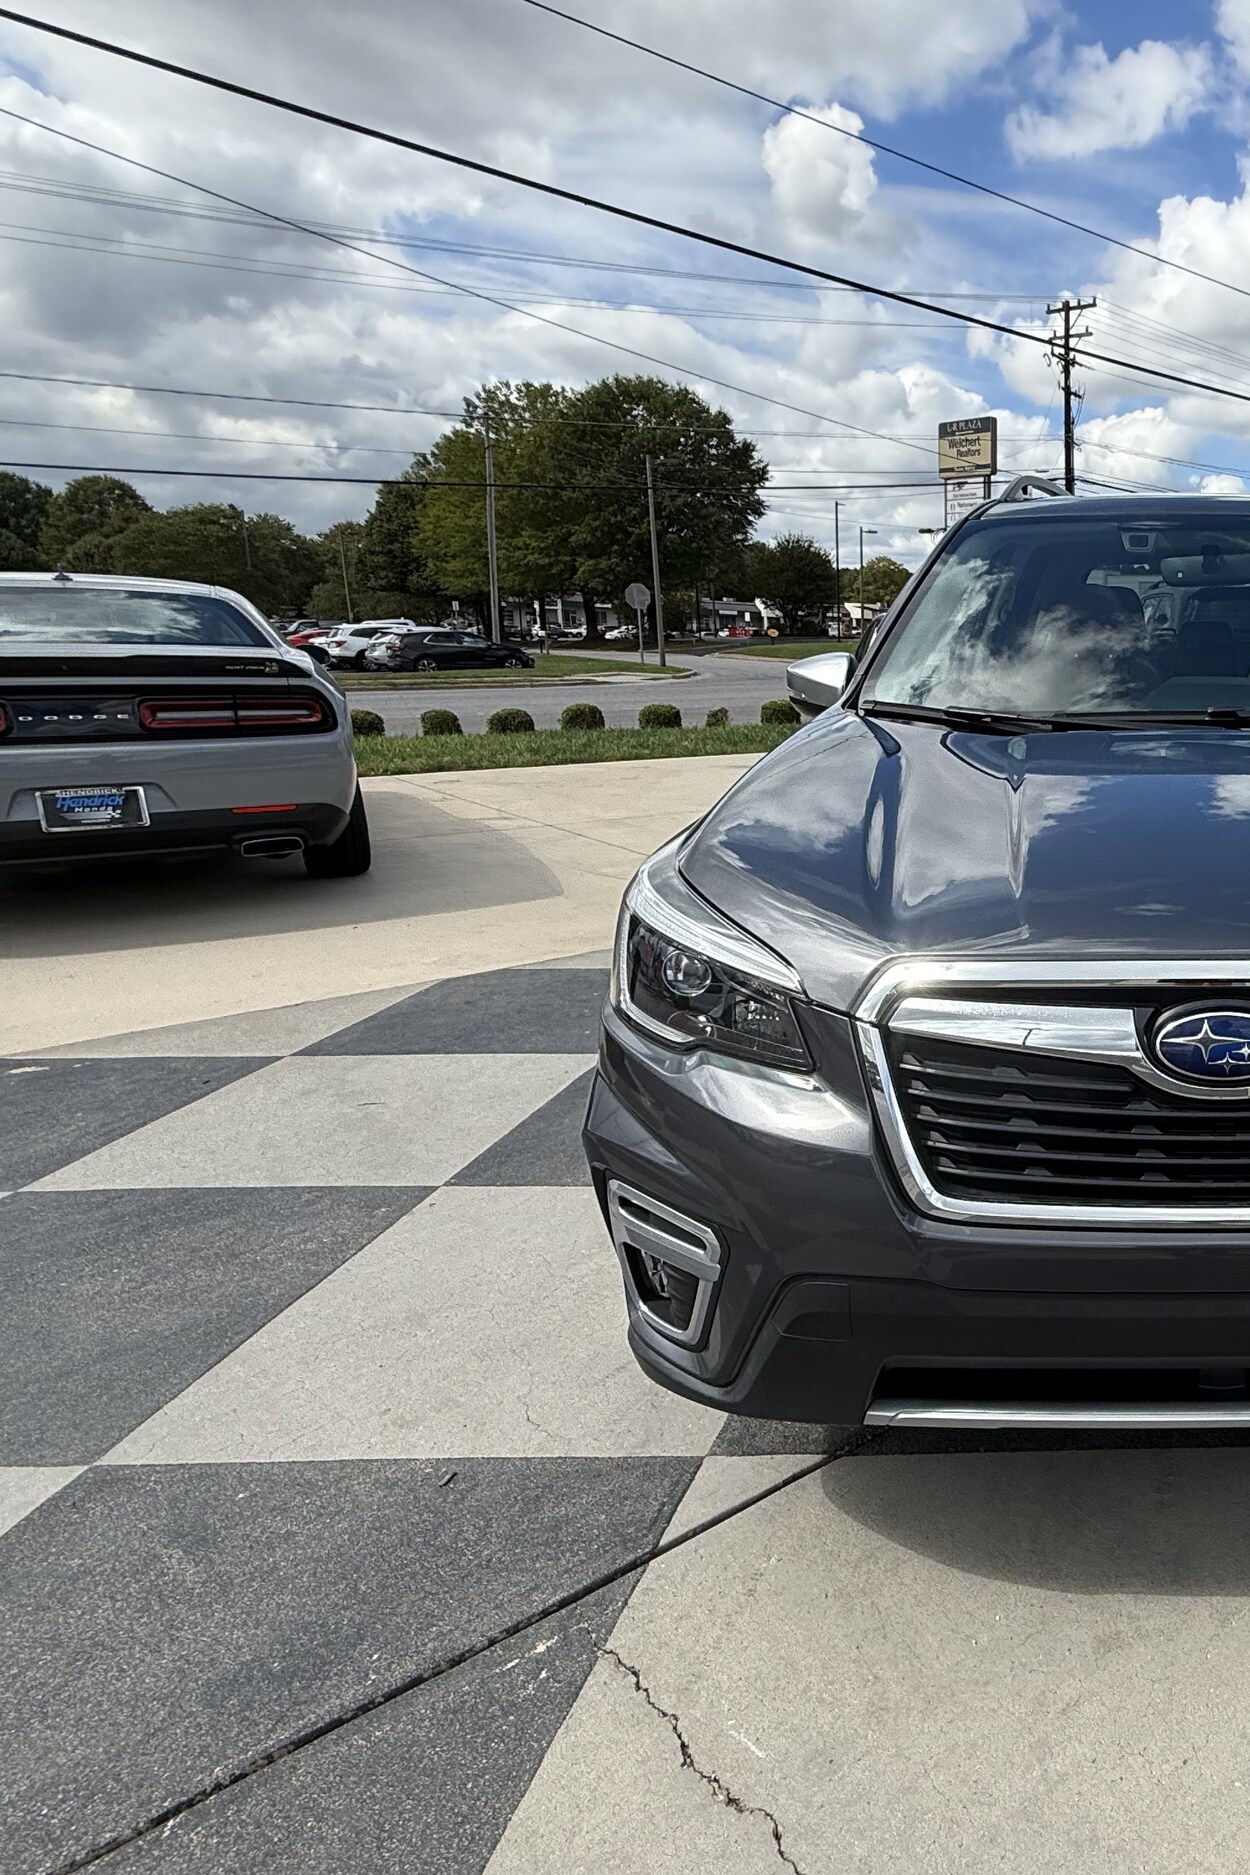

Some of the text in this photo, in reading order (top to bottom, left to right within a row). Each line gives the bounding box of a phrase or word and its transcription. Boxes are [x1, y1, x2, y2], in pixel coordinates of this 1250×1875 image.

[959, 419, 982, 430] PLAZA
[956, 448, 981, 458] Realtors
[18, 713, 130, 722] DODGE
[62, 787, 118, 796] HENDRICK
[56, 795, 125, 812] Hendrick
